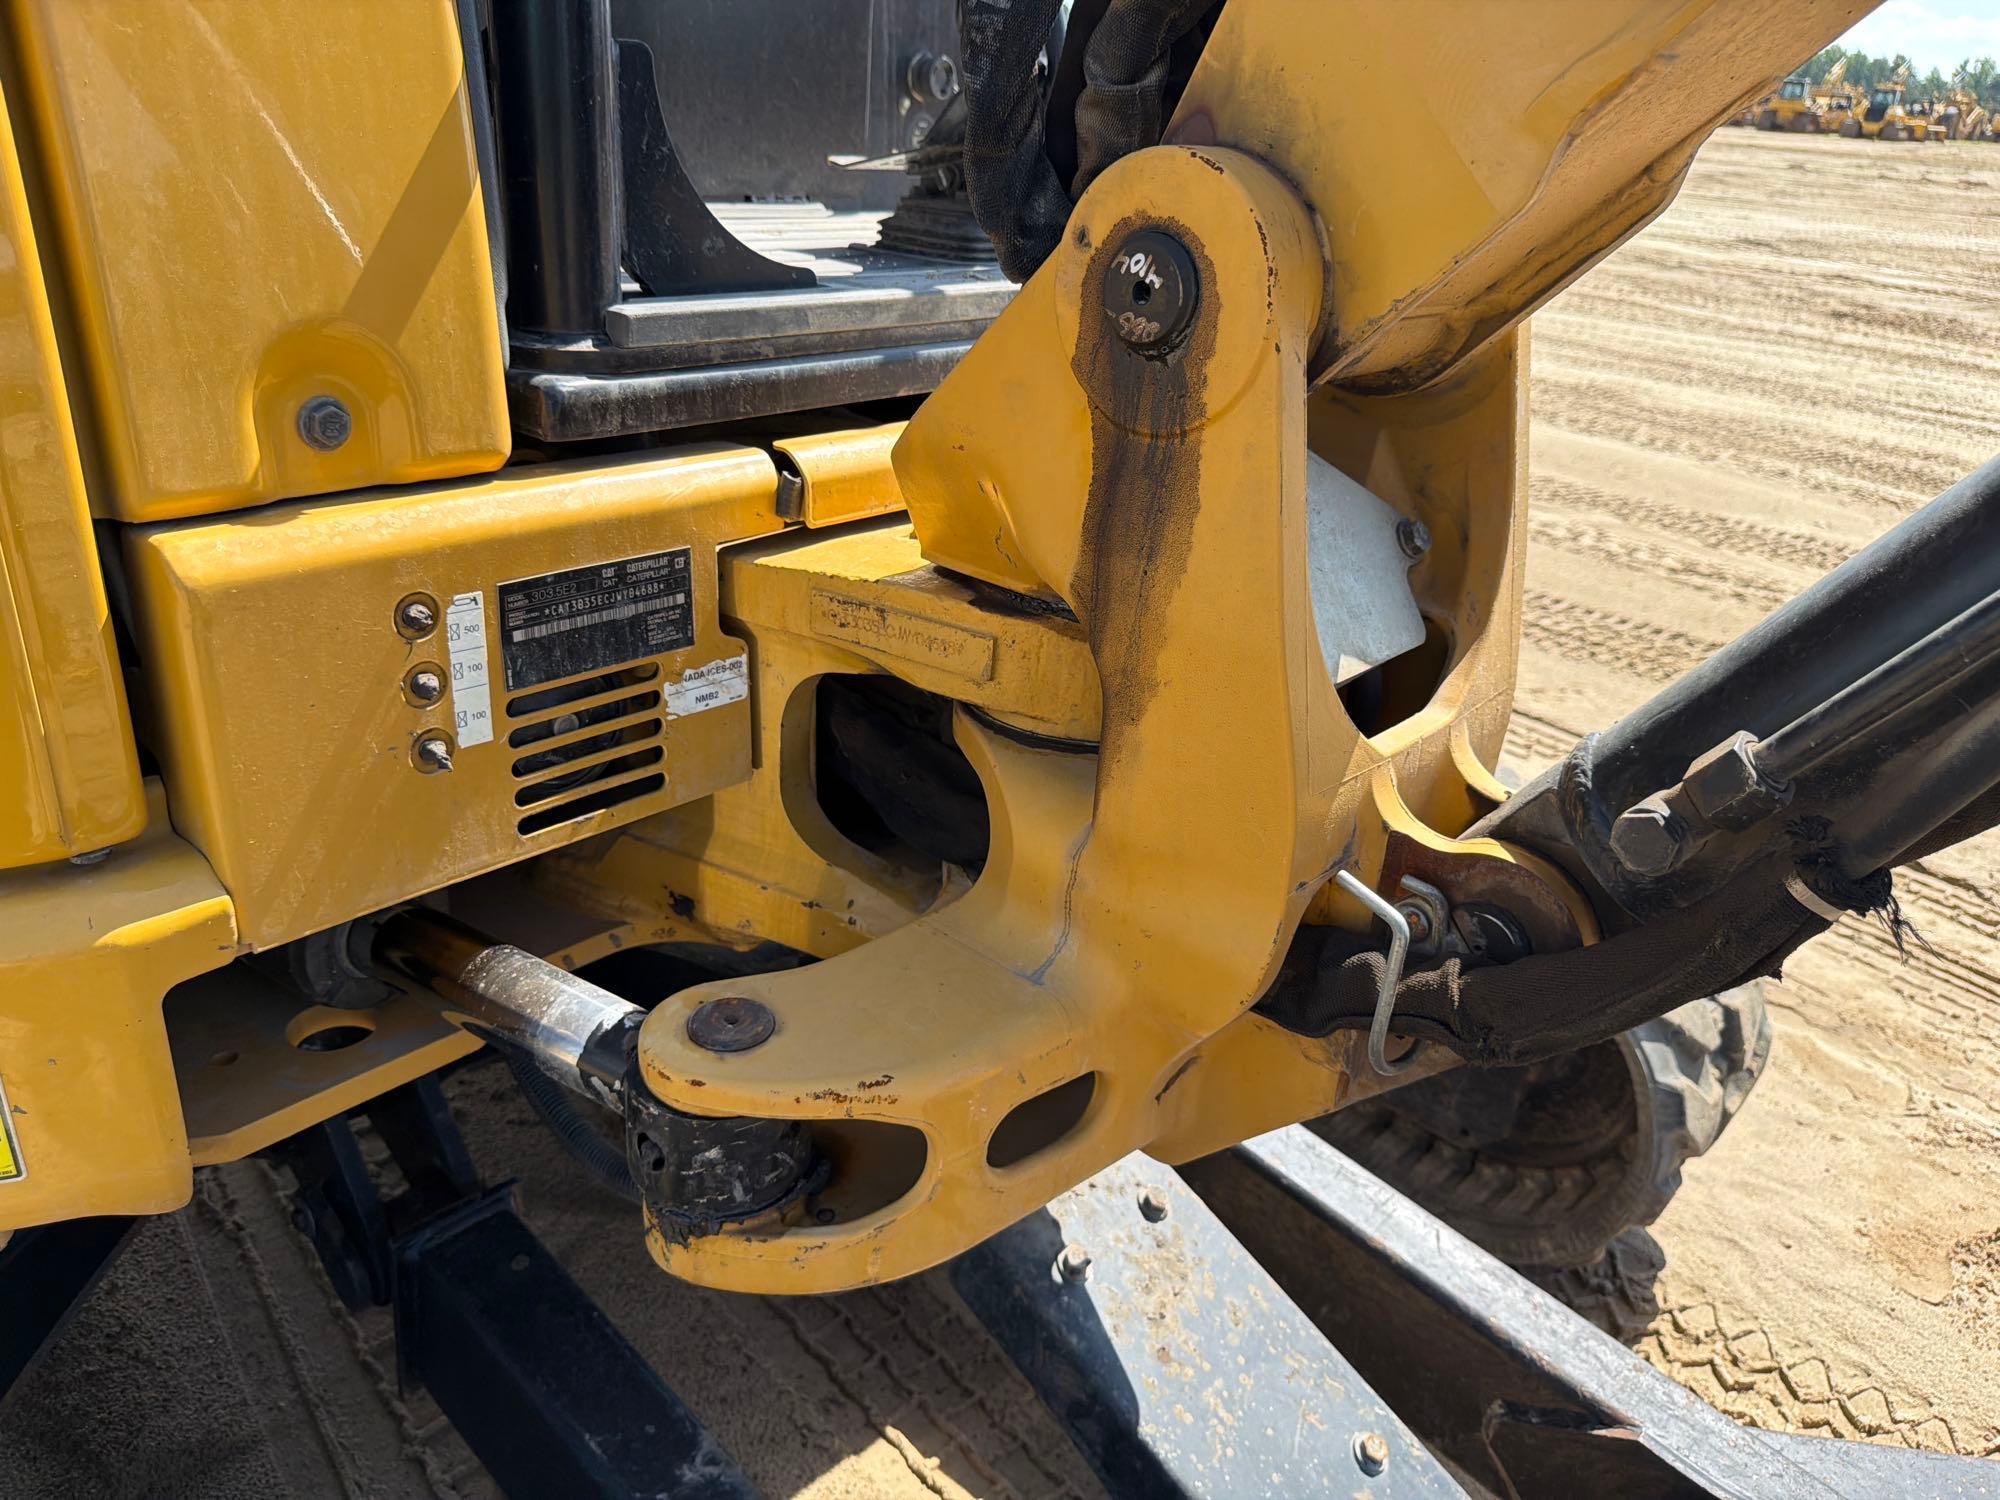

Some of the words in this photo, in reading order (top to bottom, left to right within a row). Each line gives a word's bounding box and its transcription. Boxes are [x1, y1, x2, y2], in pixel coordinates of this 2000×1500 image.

[601, 567, 616, 577] CAT
[626, 557, 669, 573] CATERPILLAR
[602, 578, 616, 588] CAT
[626, 568, 669, 584] CATERPILLAR
[531, 583, 577, 602] 303.5E2
[464, 624, 480, 635] 500
[467, 662, 483, 673] 100
[695, 690, 720, 704] NMB2
[471, 710, 487, 721] 100
